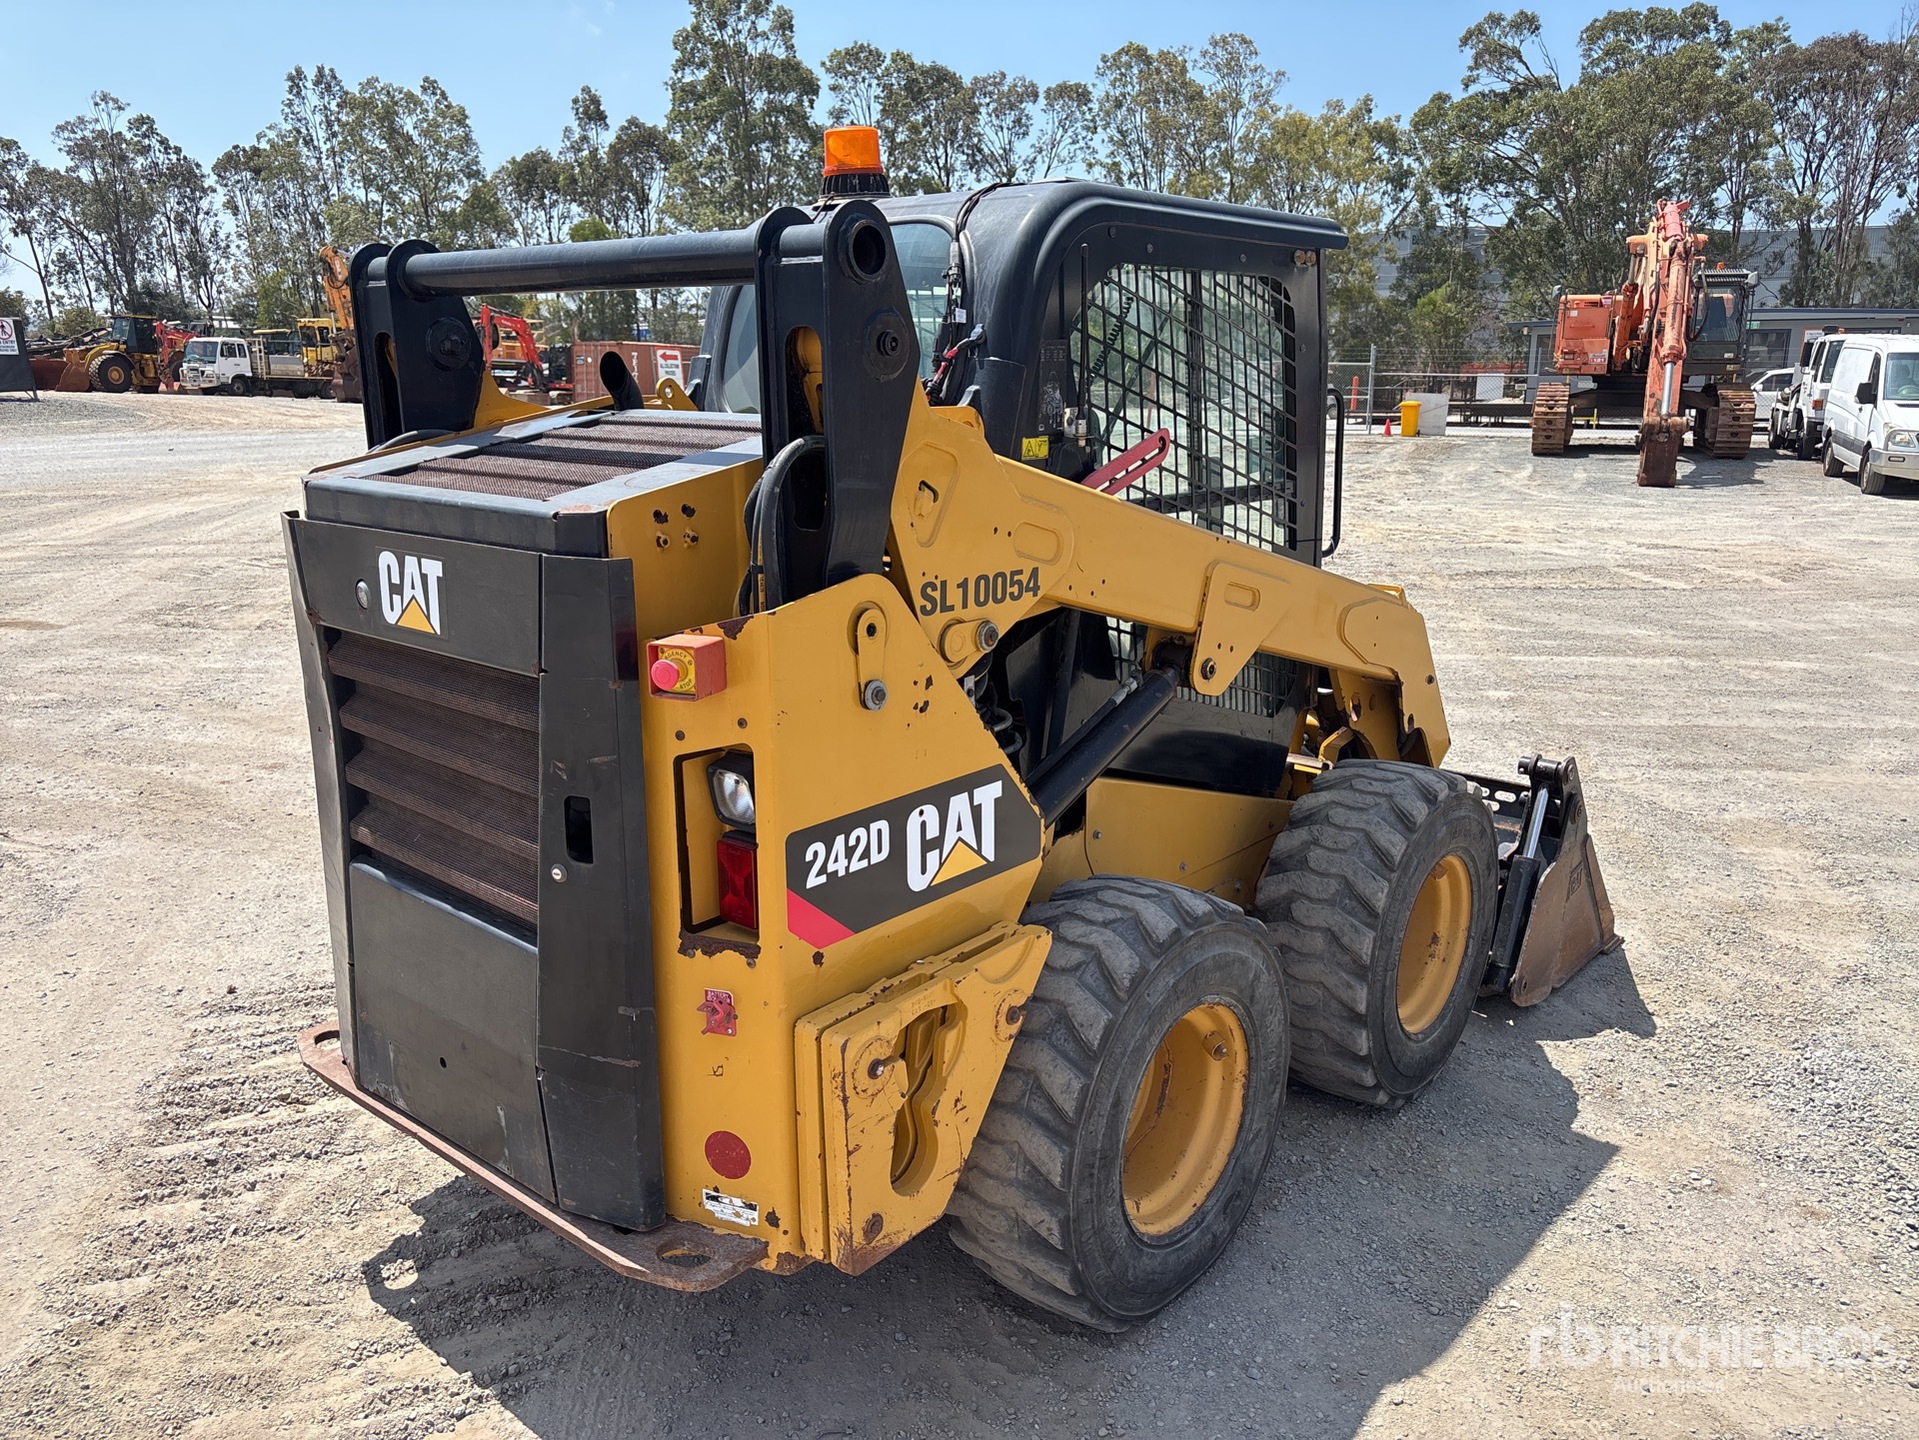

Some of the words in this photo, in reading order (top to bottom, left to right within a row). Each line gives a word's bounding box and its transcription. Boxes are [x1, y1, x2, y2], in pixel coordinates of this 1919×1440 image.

[378, 550, 443, 636] CAT
[919, 566, 1041, 617] SL10054
[805, 818, 890, 890] 242D
[906, 779, 1003, 892] CAT
